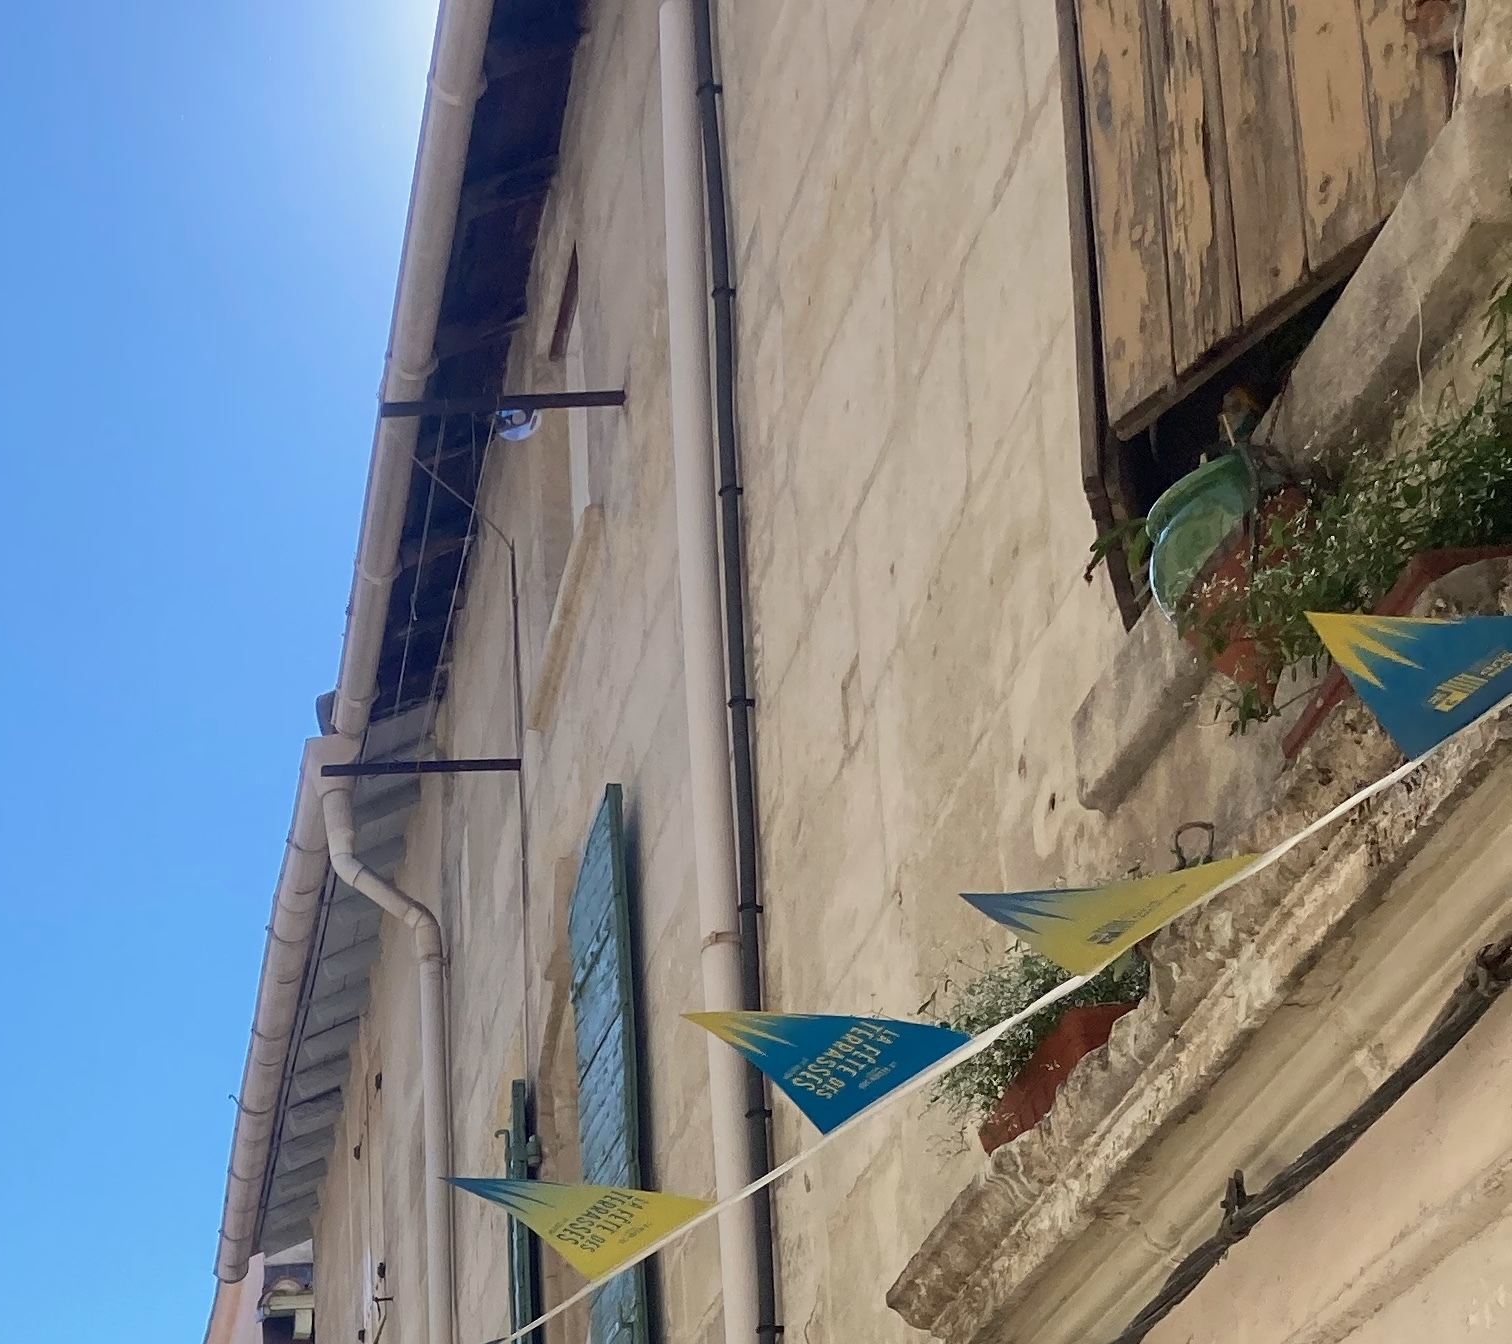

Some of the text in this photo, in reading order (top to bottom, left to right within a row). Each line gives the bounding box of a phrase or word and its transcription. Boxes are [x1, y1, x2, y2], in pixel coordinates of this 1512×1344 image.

[876, 1029, 901, 1045] LA
[792, 1021, 884, 1091] TERRASSES
[836, 1043, 881, 1077] FÊTE
[816, 1077, 846, 1100] DES
[556, 1190, 634, 1245] TERRASSES
[579, 1233, 606, 1253] DES
